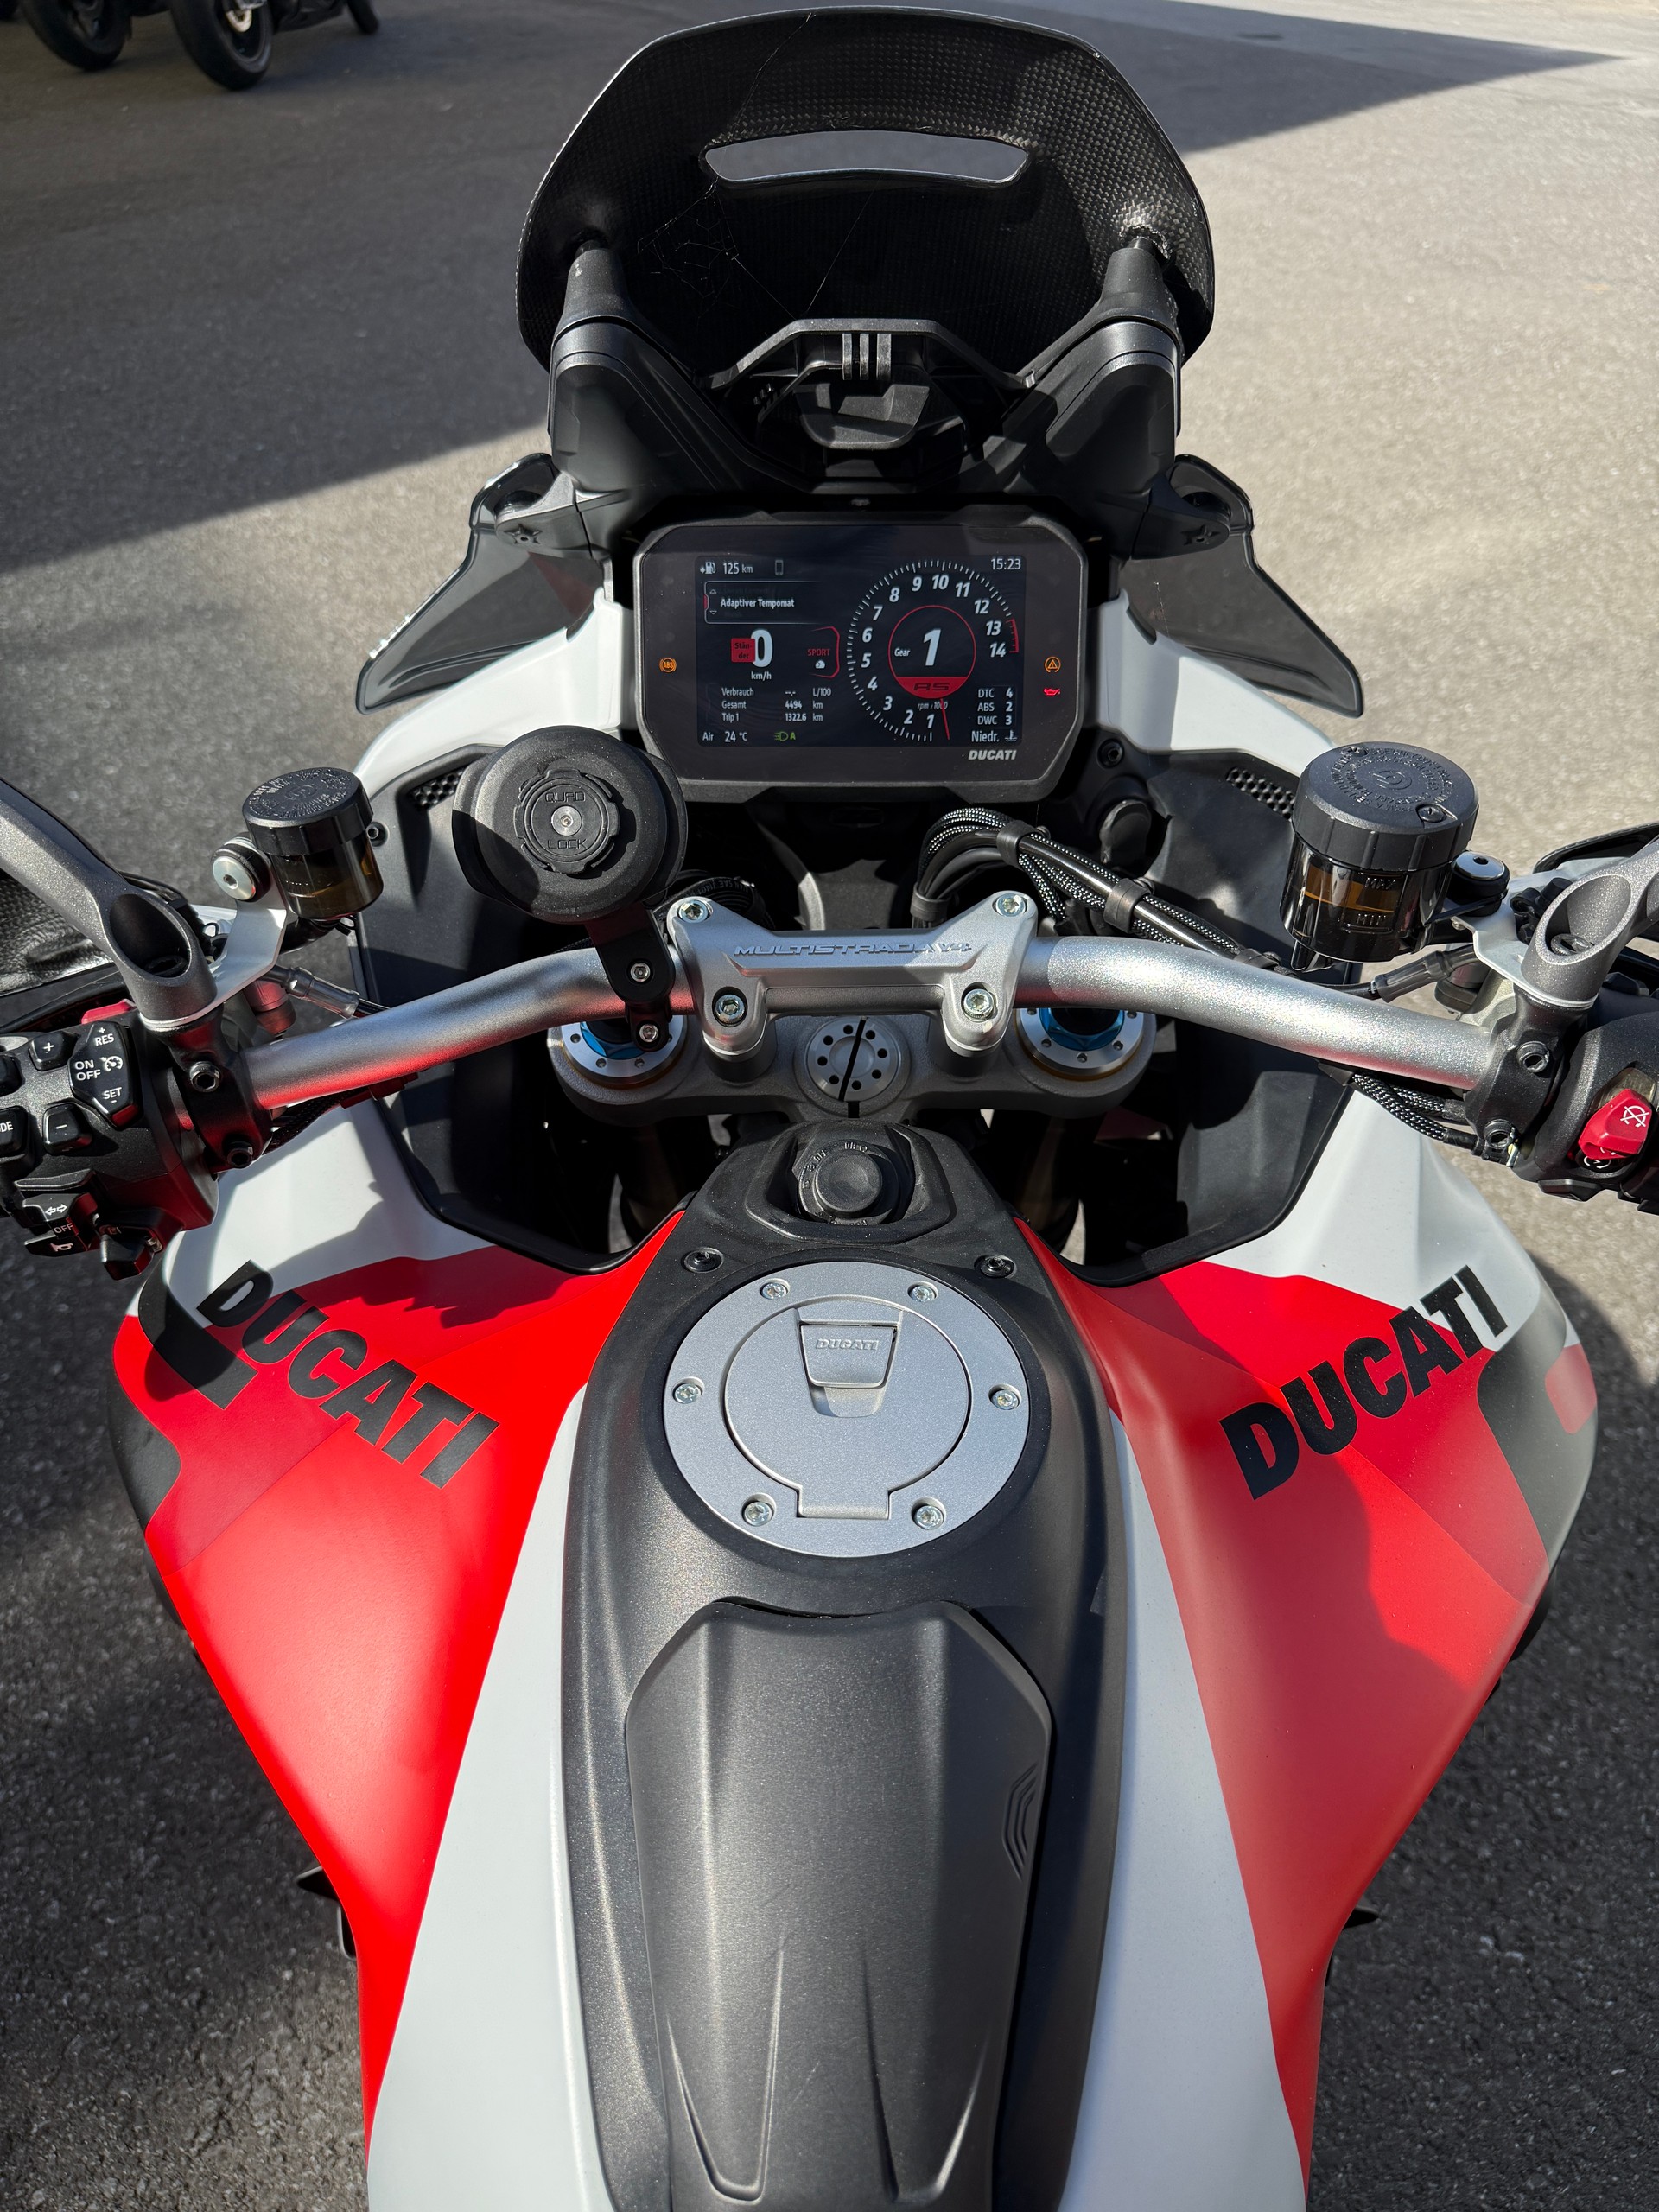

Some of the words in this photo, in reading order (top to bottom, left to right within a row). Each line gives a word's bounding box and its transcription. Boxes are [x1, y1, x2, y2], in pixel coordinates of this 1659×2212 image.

[722, 563, 739, 575] 125
[741, 564, 753, 574] km
[991, 557, 1021, 570] 15:23
[912, 575, 922, 592] 9
[931, 575, 949, 590] 10
[889, 588, 900, 602] 8
[955, 582, 970, 597] 11
[721, 598, 756, 609] Adaptiver
[758, 598, 795, 609] Tempomat
[974, 600, 989, 614] 12
[873, 606, 883, 620] 7
[986, 620, 1001, 636] 13
[862, 627, 873, 643] 6
[750, 628, 773, 668] 0
[807, 648, 830, 657] SPORT
[894, 648, 910, 657] Gear
[923, 629, 941, 666] 1
[989, 642, 1006, 658] 14
[861, 652, 871, 668] 5
[751, 671, 772, 681] km/h
[868, 677, 878, 690] 4
[913, 683, 950, 691] RS
[721, 687, 754, 696] Verbrauch
[812, 688, 832, 696] L/100
[978, 689, 995, 698] DTC
[1006, 688, 1014, 698] 4
[721, 700, 747, 709] Gesamt
[785, 701, 802, 709] 4494
[812, 701, 823, 709] km
[883, 696, 893, 710] 3
[977, 702, 995, 712] ABS
[1006, 702, 1014, 712] 2
[722, 713, 734, 723] Trip
[735, 713, 740, 721] 1
[785, 713, 807, 722] 1322.6
[812, 713, 823, 721] km
[904, 709, 914, 724] 2
[926, 714, 935, 728] 1
[977, 715, 997, 725] DWC
[1005, 715, 1013, 726] 3
[702, 732, 715, 741] Air
[724, 731, 736, 742] 24
[739, 733, 747, 741] °C
[971, 730, 1000, 742] Niedr.
[968, 749, 1017, 760] DUCATI
[544, 791, 586, 803] QUAD
[547, 838, 588, 849] LOCK
[734, 944, 935, 957] MULTISTRADA
[95, 1033, 114, 1046] RES
[74, 1059, 94, 1070] ON
[76, 1069, 101, 1082] OFF
[103, 1086, 122, 1099] SET
[54, 1223, 73, 1234] OFF
[816, 1338, 879, 1351] DUCATI
[196, 1259, 500, 1489] DUCATI
[1219, 1265, 1508, 1500] DUCATI
